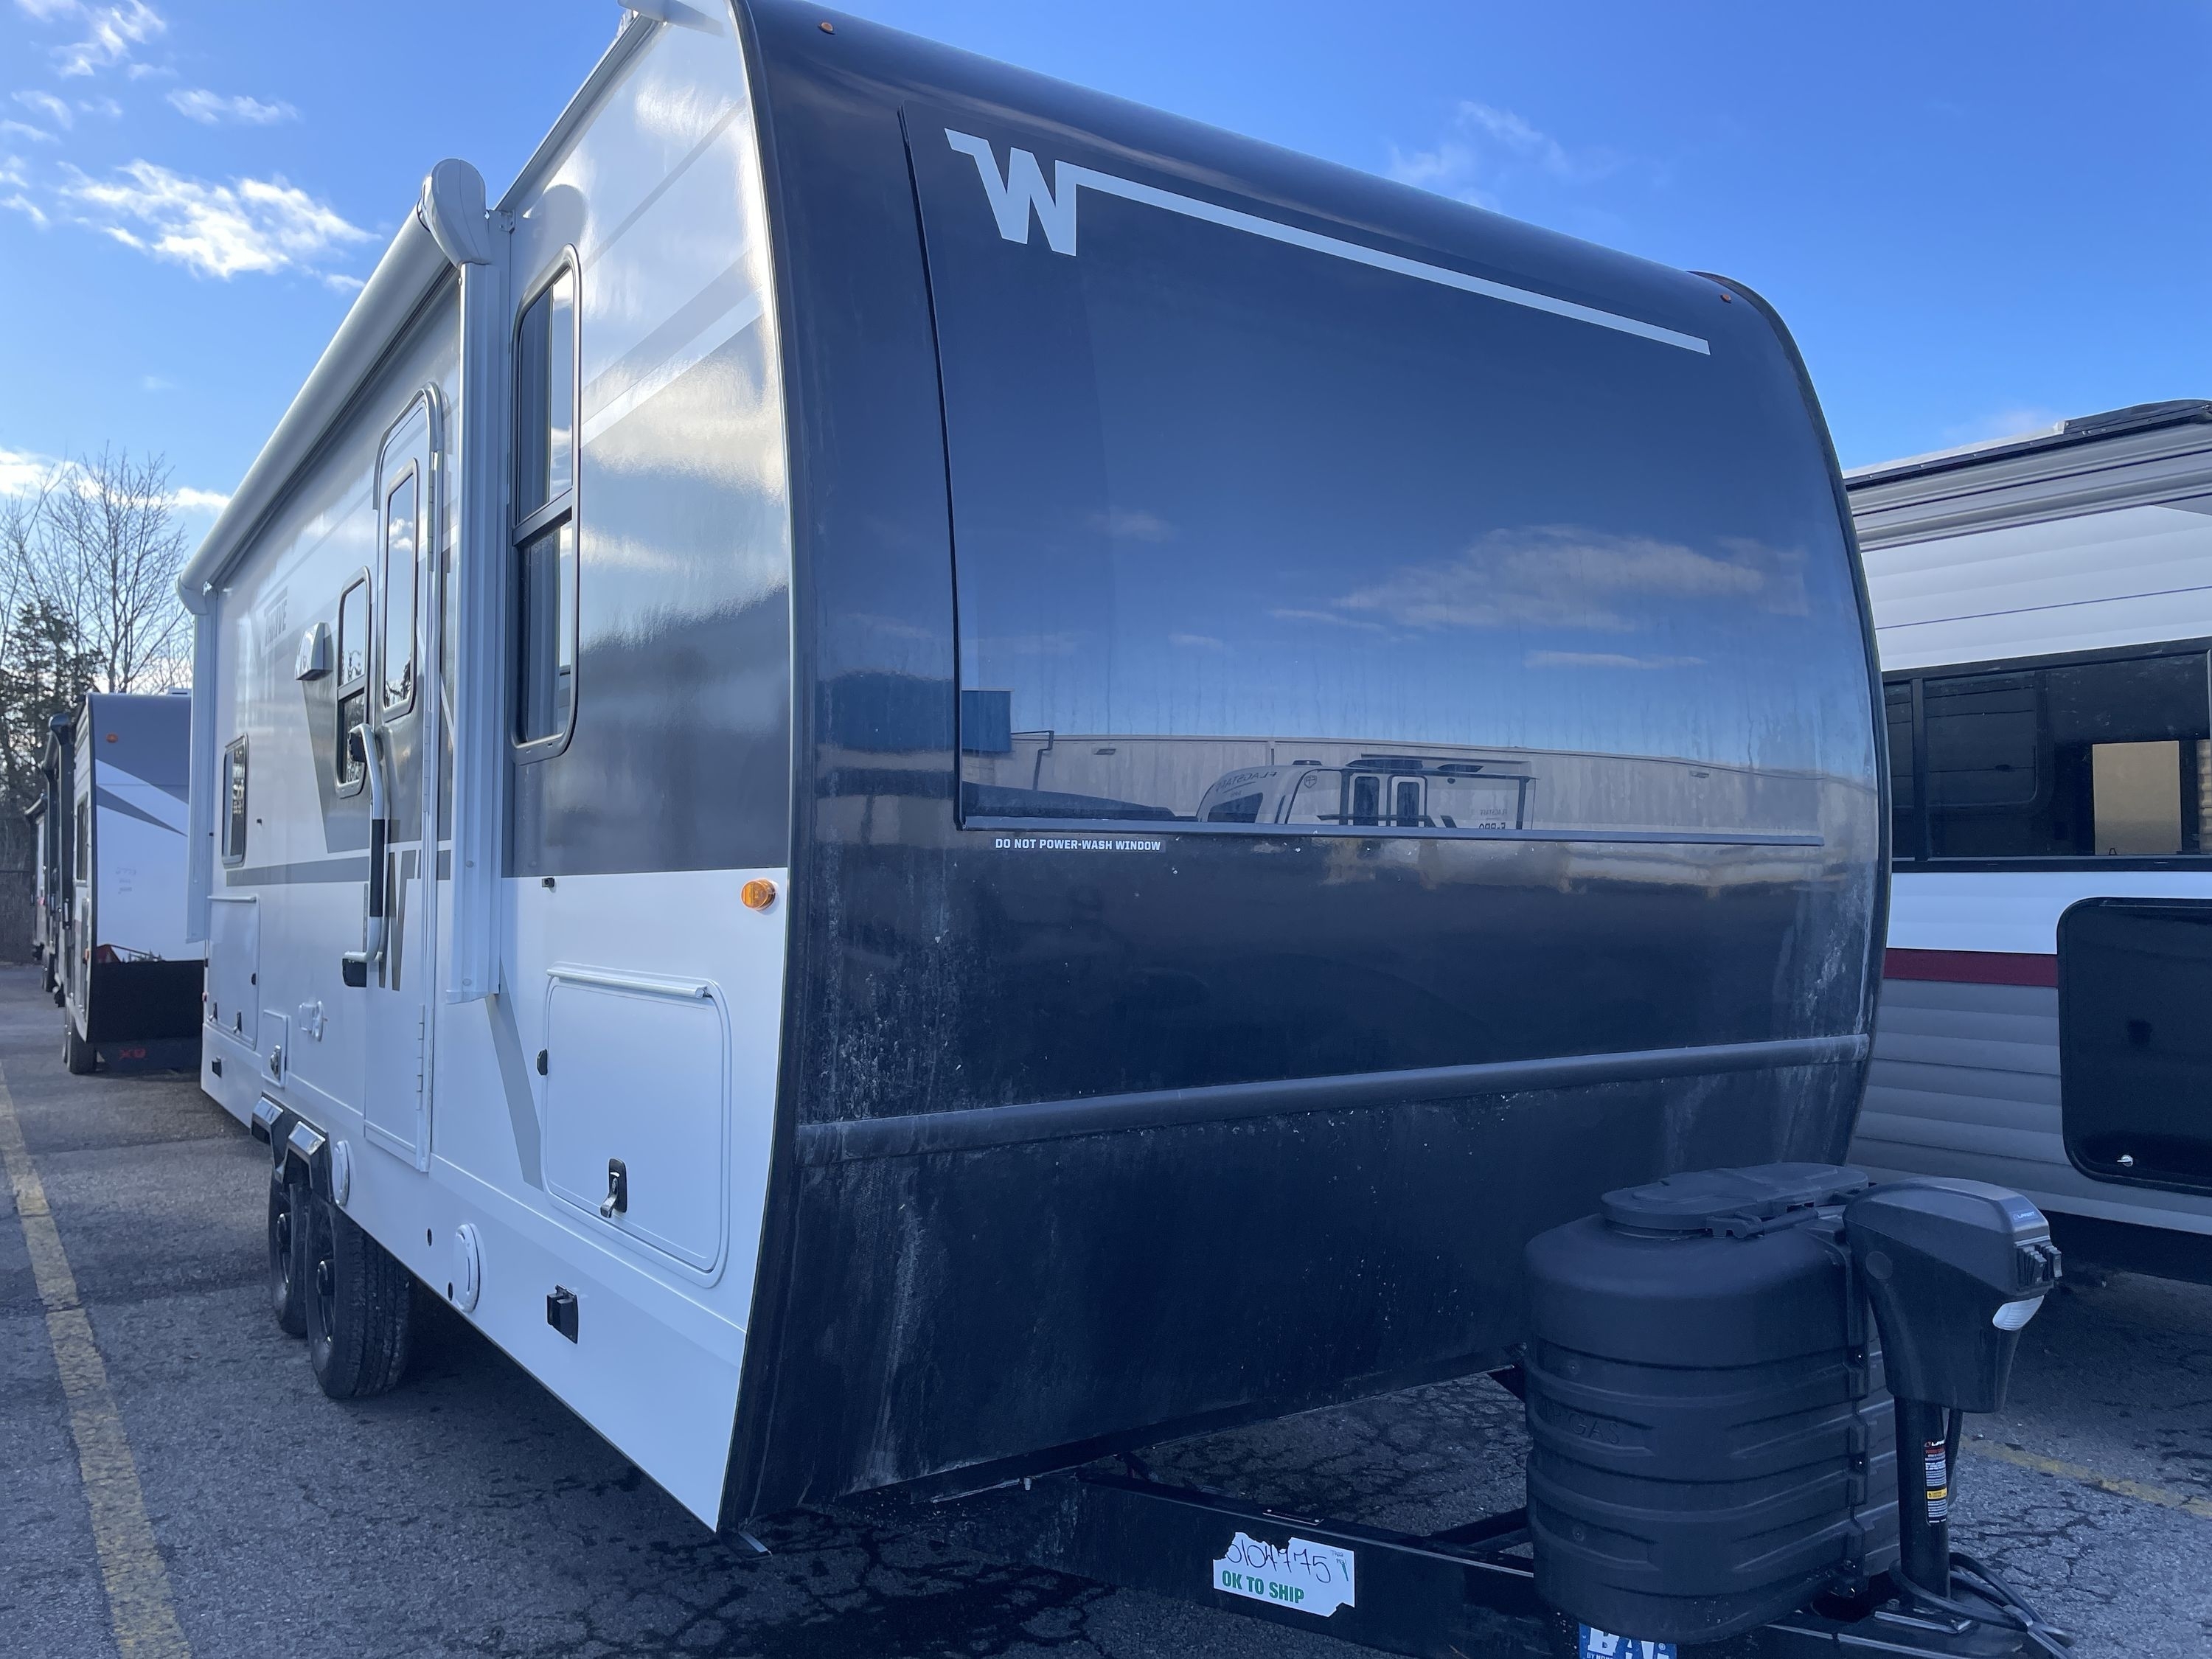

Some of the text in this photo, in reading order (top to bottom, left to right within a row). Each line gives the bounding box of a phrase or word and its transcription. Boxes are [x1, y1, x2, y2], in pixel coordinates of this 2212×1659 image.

[945, 128, 1077, 257] W
[995, 838, 1161, 851] DO NOT POWER-WASH WINDOW
[1568, 1412, 1621, 1444] GAS
[1222, 1570, 1304, 1603] OK TO SHIP
